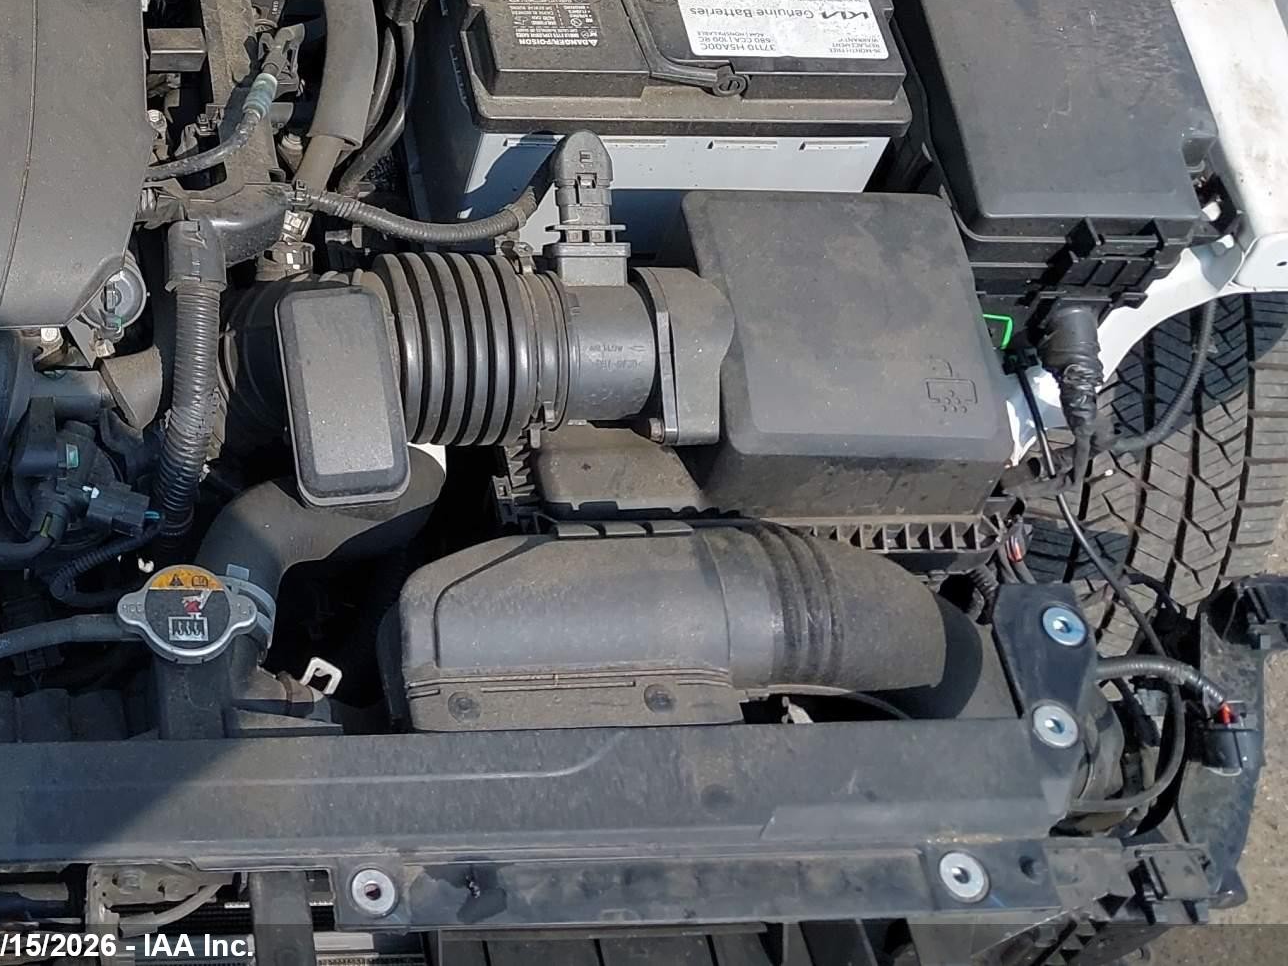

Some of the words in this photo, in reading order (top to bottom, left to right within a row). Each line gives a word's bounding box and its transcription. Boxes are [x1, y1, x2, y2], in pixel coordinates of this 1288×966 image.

[689, 7, 752, 18] Batteries
[756, 8, 814, 19] Genuine
[747, 43, 775, 51] 37110
